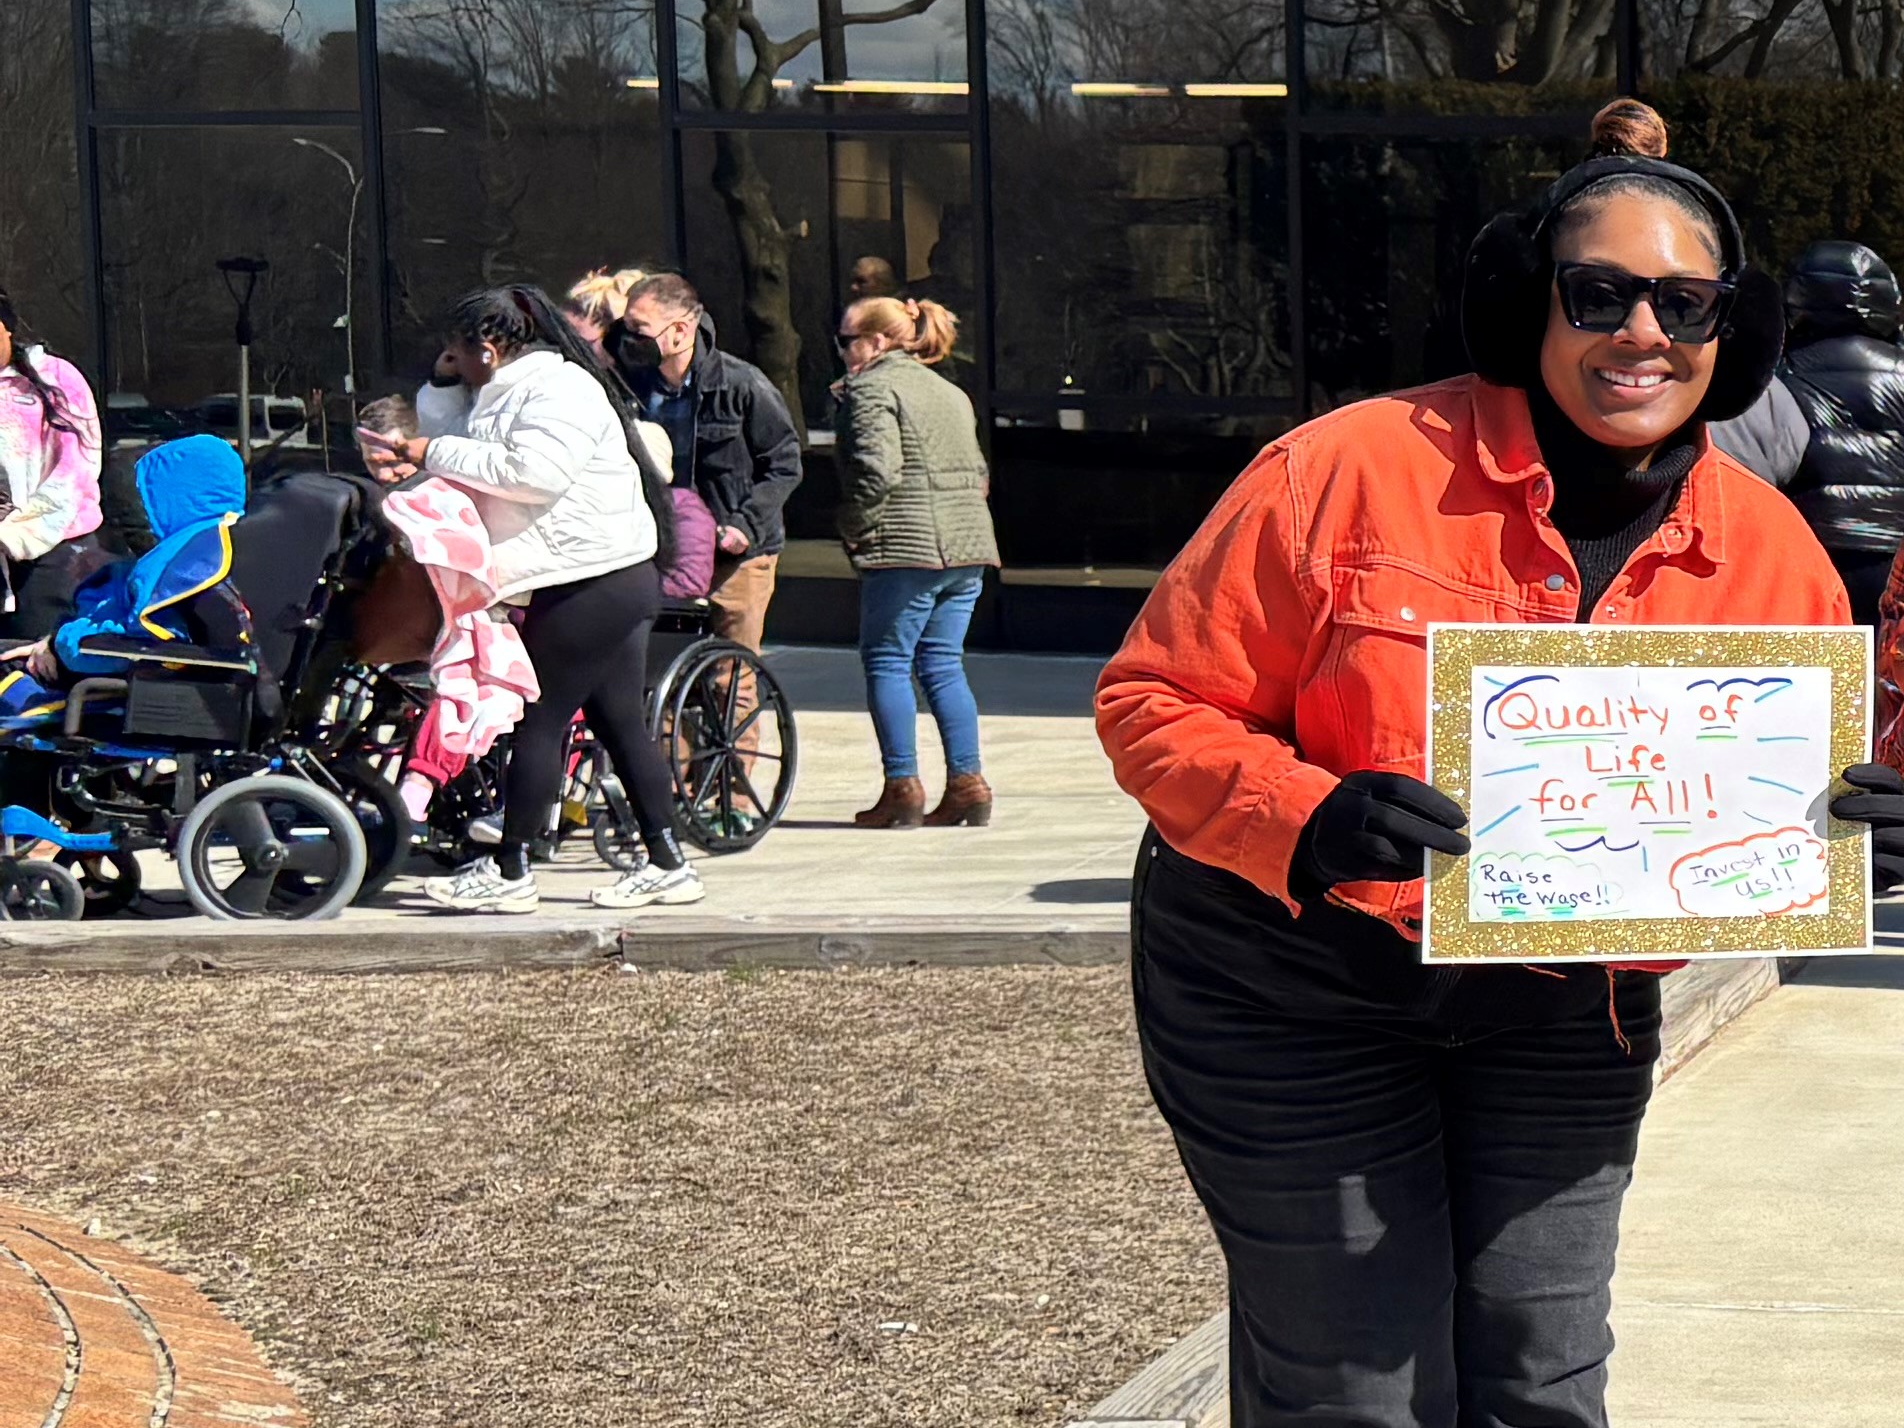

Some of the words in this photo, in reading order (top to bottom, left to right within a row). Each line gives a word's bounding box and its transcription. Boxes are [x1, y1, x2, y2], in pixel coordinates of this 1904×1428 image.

[1498, 693, 1669, 735] Quality
[1699, 695, 1743, 723] of
[1585, 744, 1666, 773] Life
[1530, 779, 1598, 814] for
[1480, 864, 1552, 883] Raise
[1689, 851, 1765, 884] Invest
[1484, 889, 1532, 905] the
